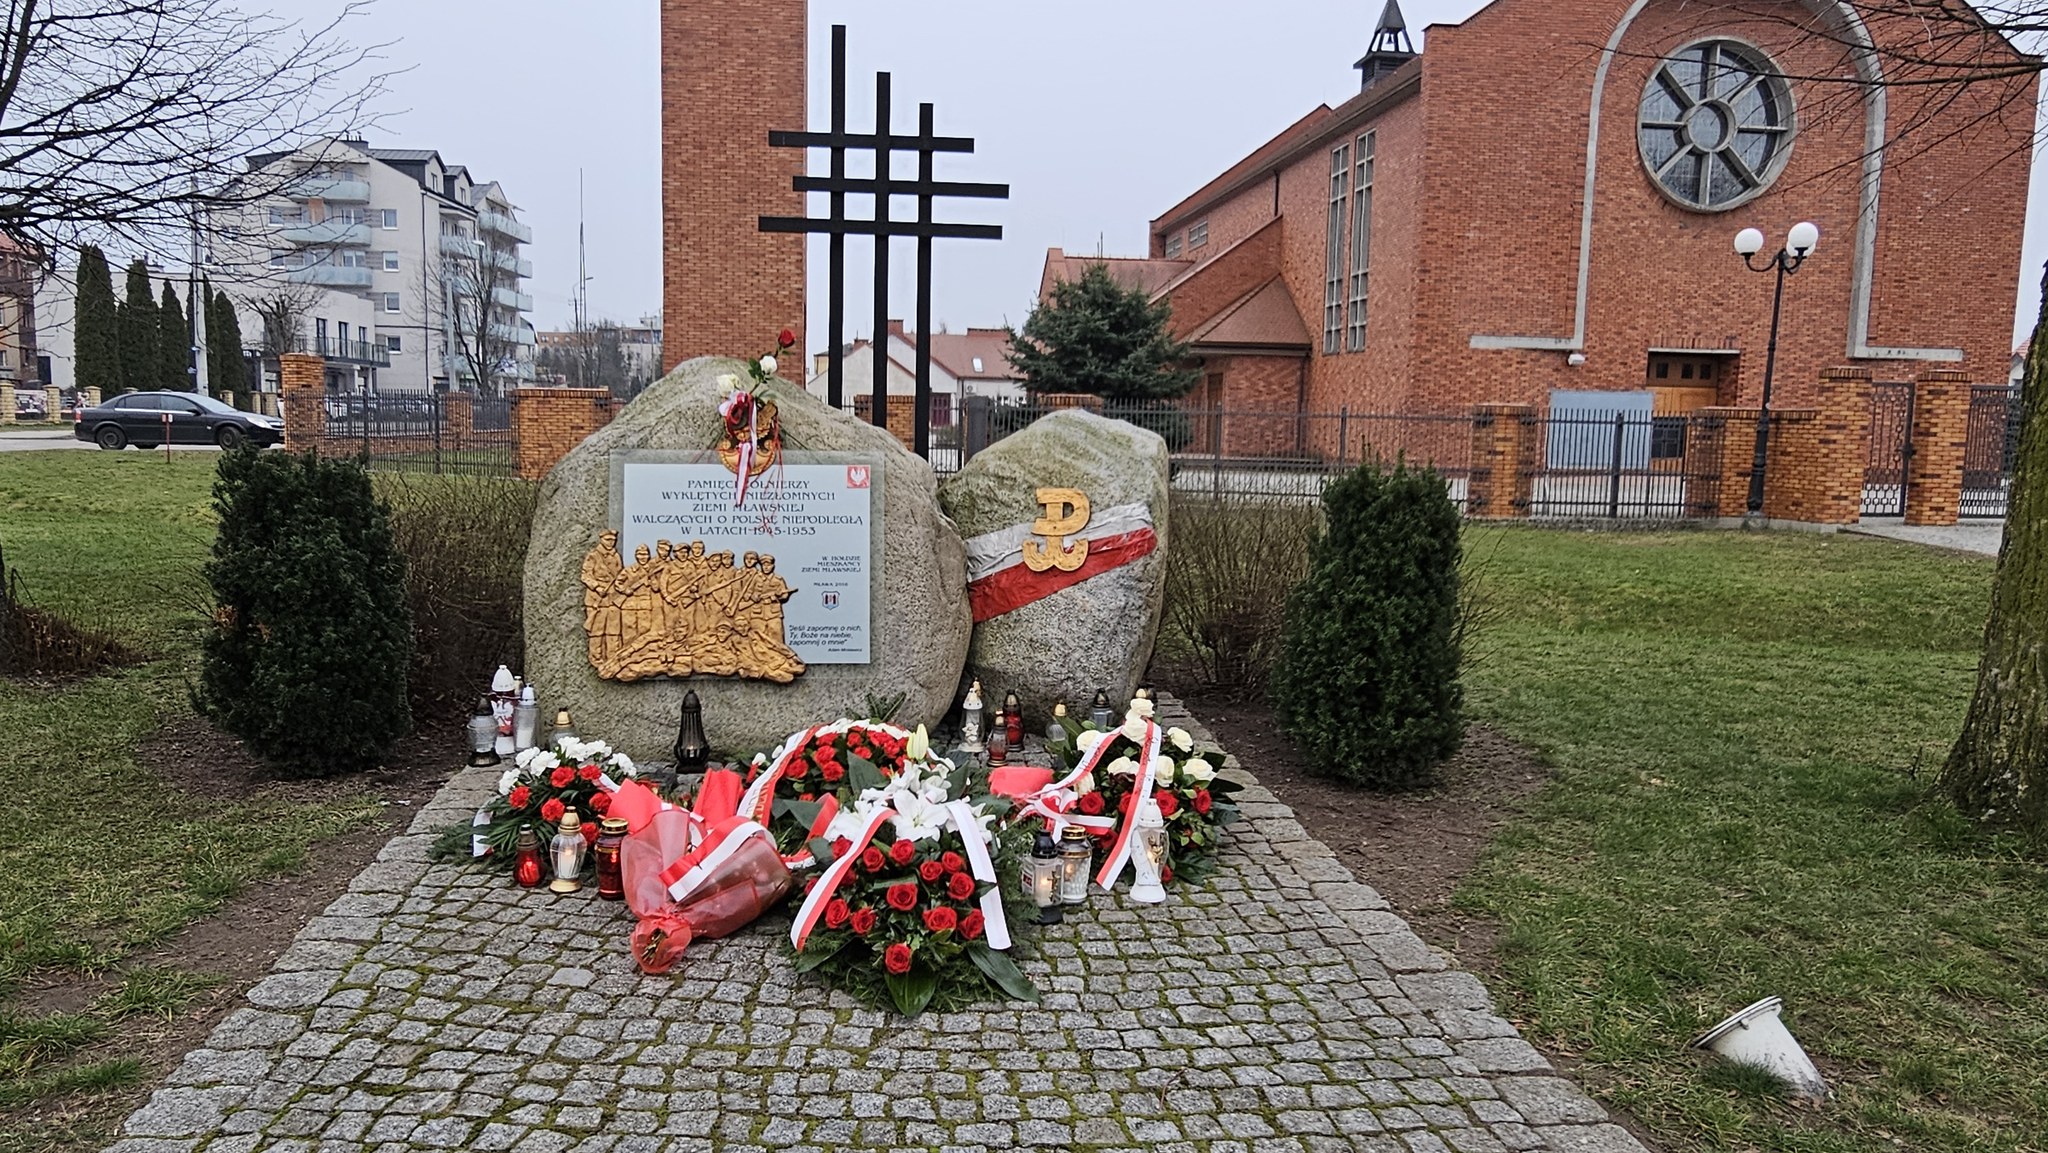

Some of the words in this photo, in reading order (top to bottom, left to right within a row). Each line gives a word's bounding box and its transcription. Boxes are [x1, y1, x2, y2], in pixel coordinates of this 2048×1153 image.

[745, 479, 810, 489] OŁNIERZY
[661, 491, 737, 501] WYKLĘTYCH
[746, 491, 835, 501] NIEZŁOMNYCH
[692, 503, 727, 512] ZIEMI
[733, 503, 805, 512] MŁAWSKIEJ
[632, 515, 712, 525] WALCZĄCYCH
[717, 515, 727, 524] O
[732, 515, 778, 525] POLSKĘ
[782, 515, 863, 525] NIEPODLEGŁĄ
[681, 526, 692, 535] W
[699, 526, 747, 535] LATACH
